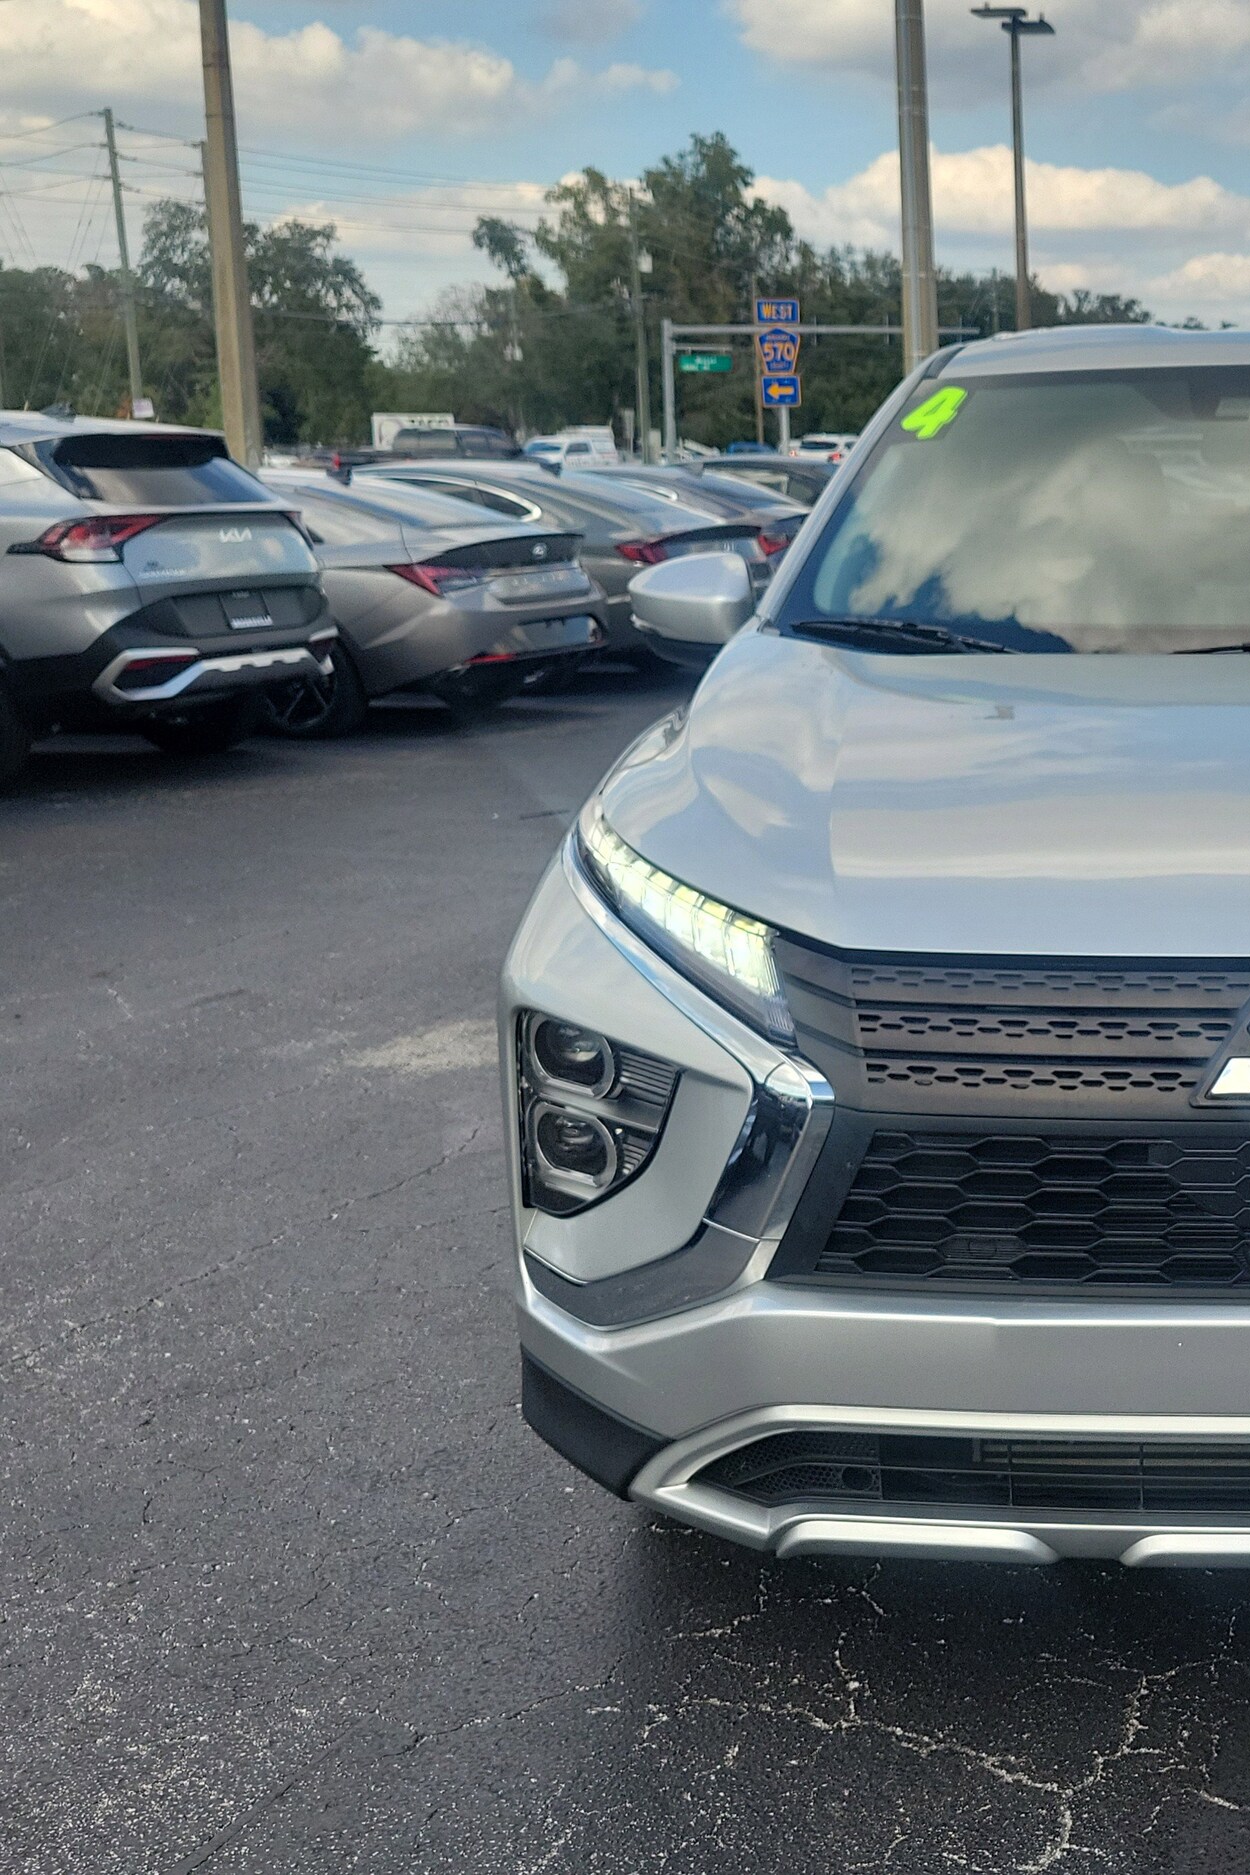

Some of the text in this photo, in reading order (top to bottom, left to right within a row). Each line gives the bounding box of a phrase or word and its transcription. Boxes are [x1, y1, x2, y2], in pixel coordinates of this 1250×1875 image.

[762, 302, 793, 320] WEST
[763, 341, 796, 362] 570
[901, 386, 968, 440] 4
